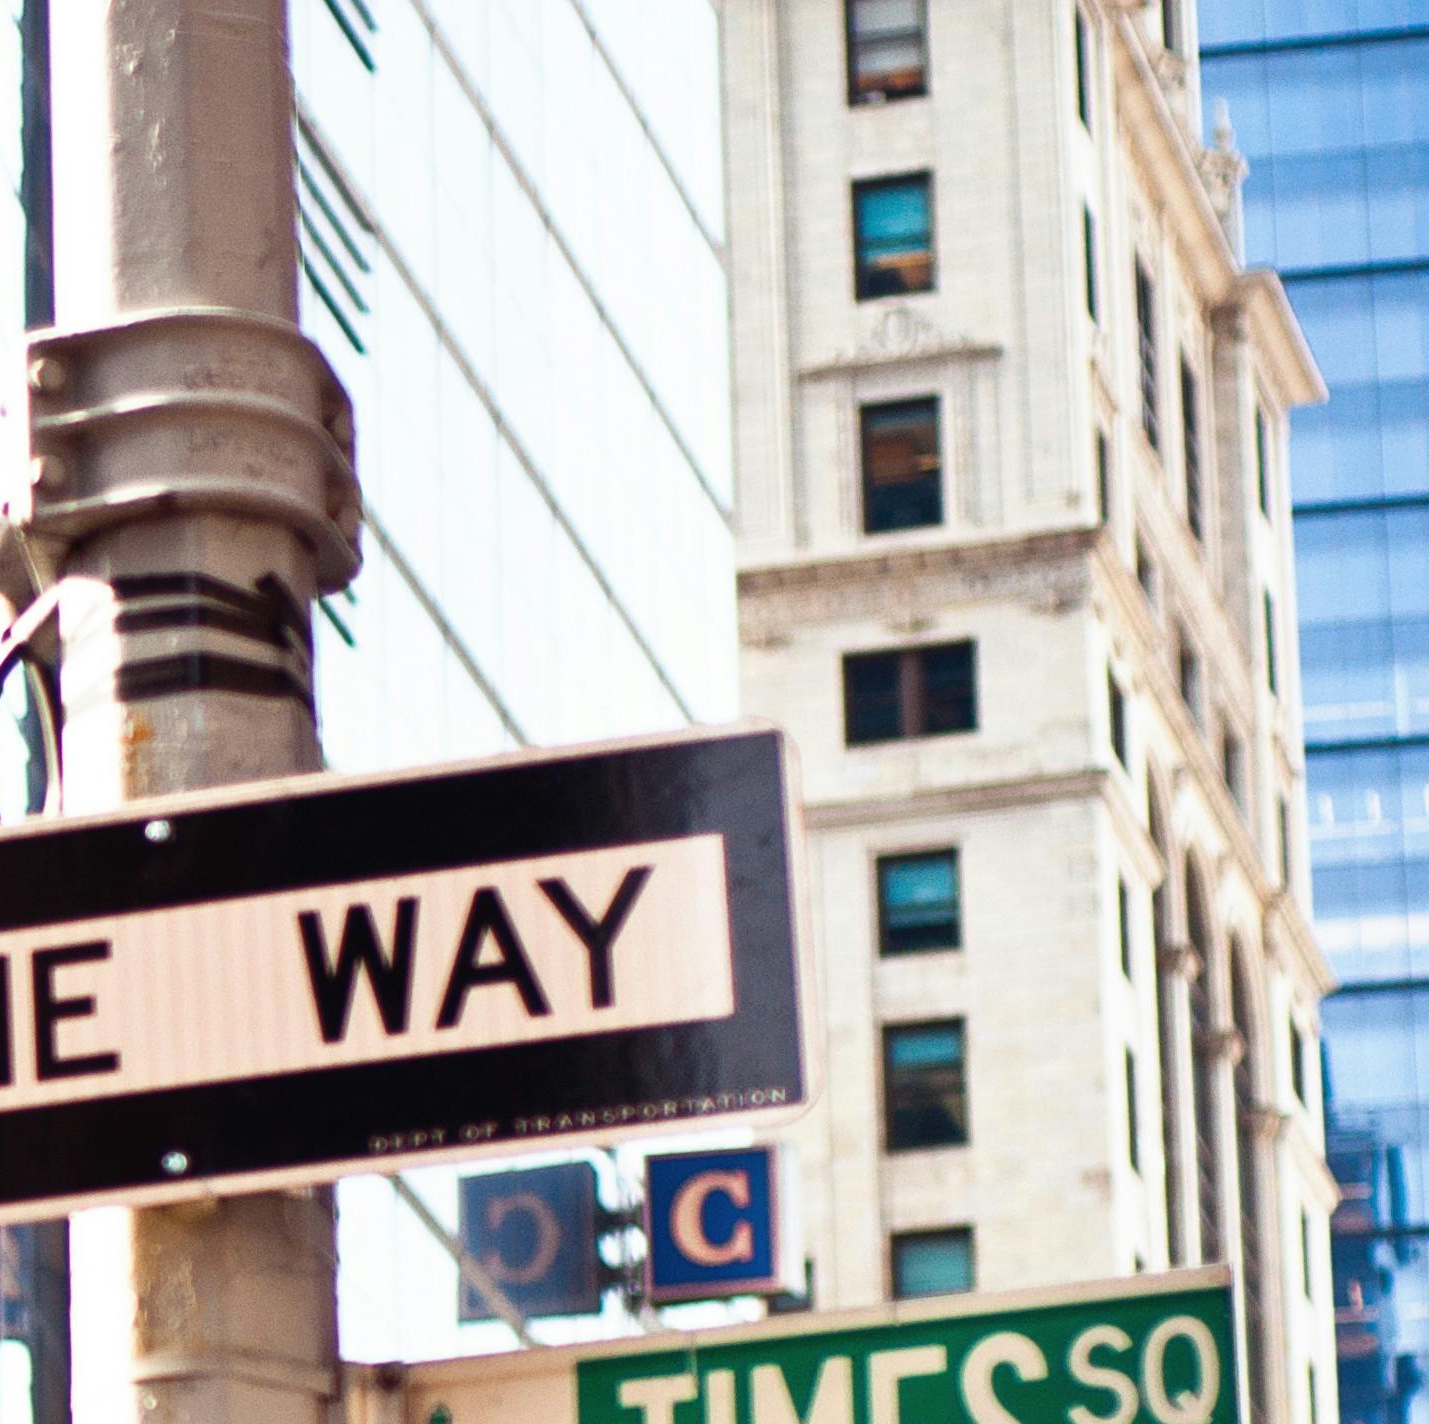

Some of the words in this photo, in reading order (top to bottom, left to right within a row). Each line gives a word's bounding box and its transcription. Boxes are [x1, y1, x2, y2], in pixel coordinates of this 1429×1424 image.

[295, 865, 656, 1044] WAY
[367, 1131, 445, 1153] DEPT
[459, 1123, 499, 1142] OF
[515, 1087, 788, 1135] TRANSPORTATION
